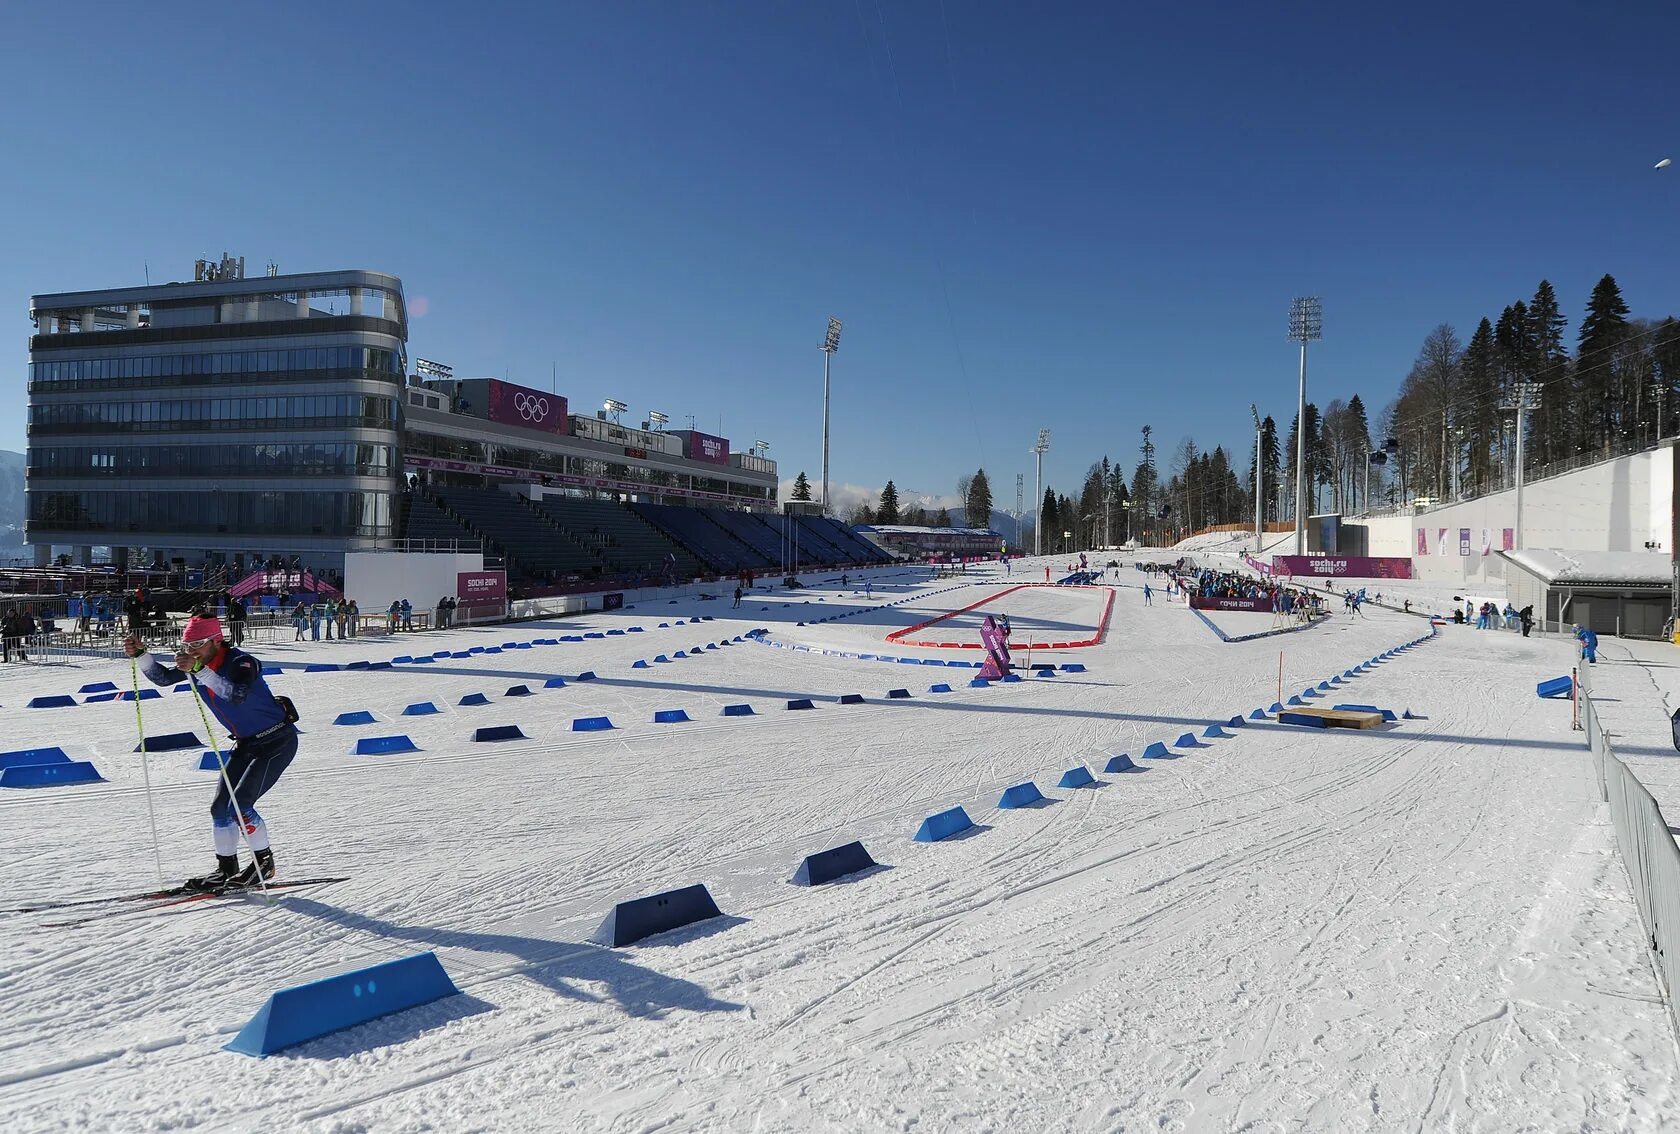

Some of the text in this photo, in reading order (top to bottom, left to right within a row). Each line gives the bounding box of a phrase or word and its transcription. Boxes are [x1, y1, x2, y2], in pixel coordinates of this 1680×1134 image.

[1310, 558, 1347, 567] sochi.ru
[1313, 566, 1334, 575] 2014
[467, 578, 498, 587] SOCHI 2014
[1238, 600, 1255, 608] 2014
[255, 721, 286, 739] ROSSIGNOL
